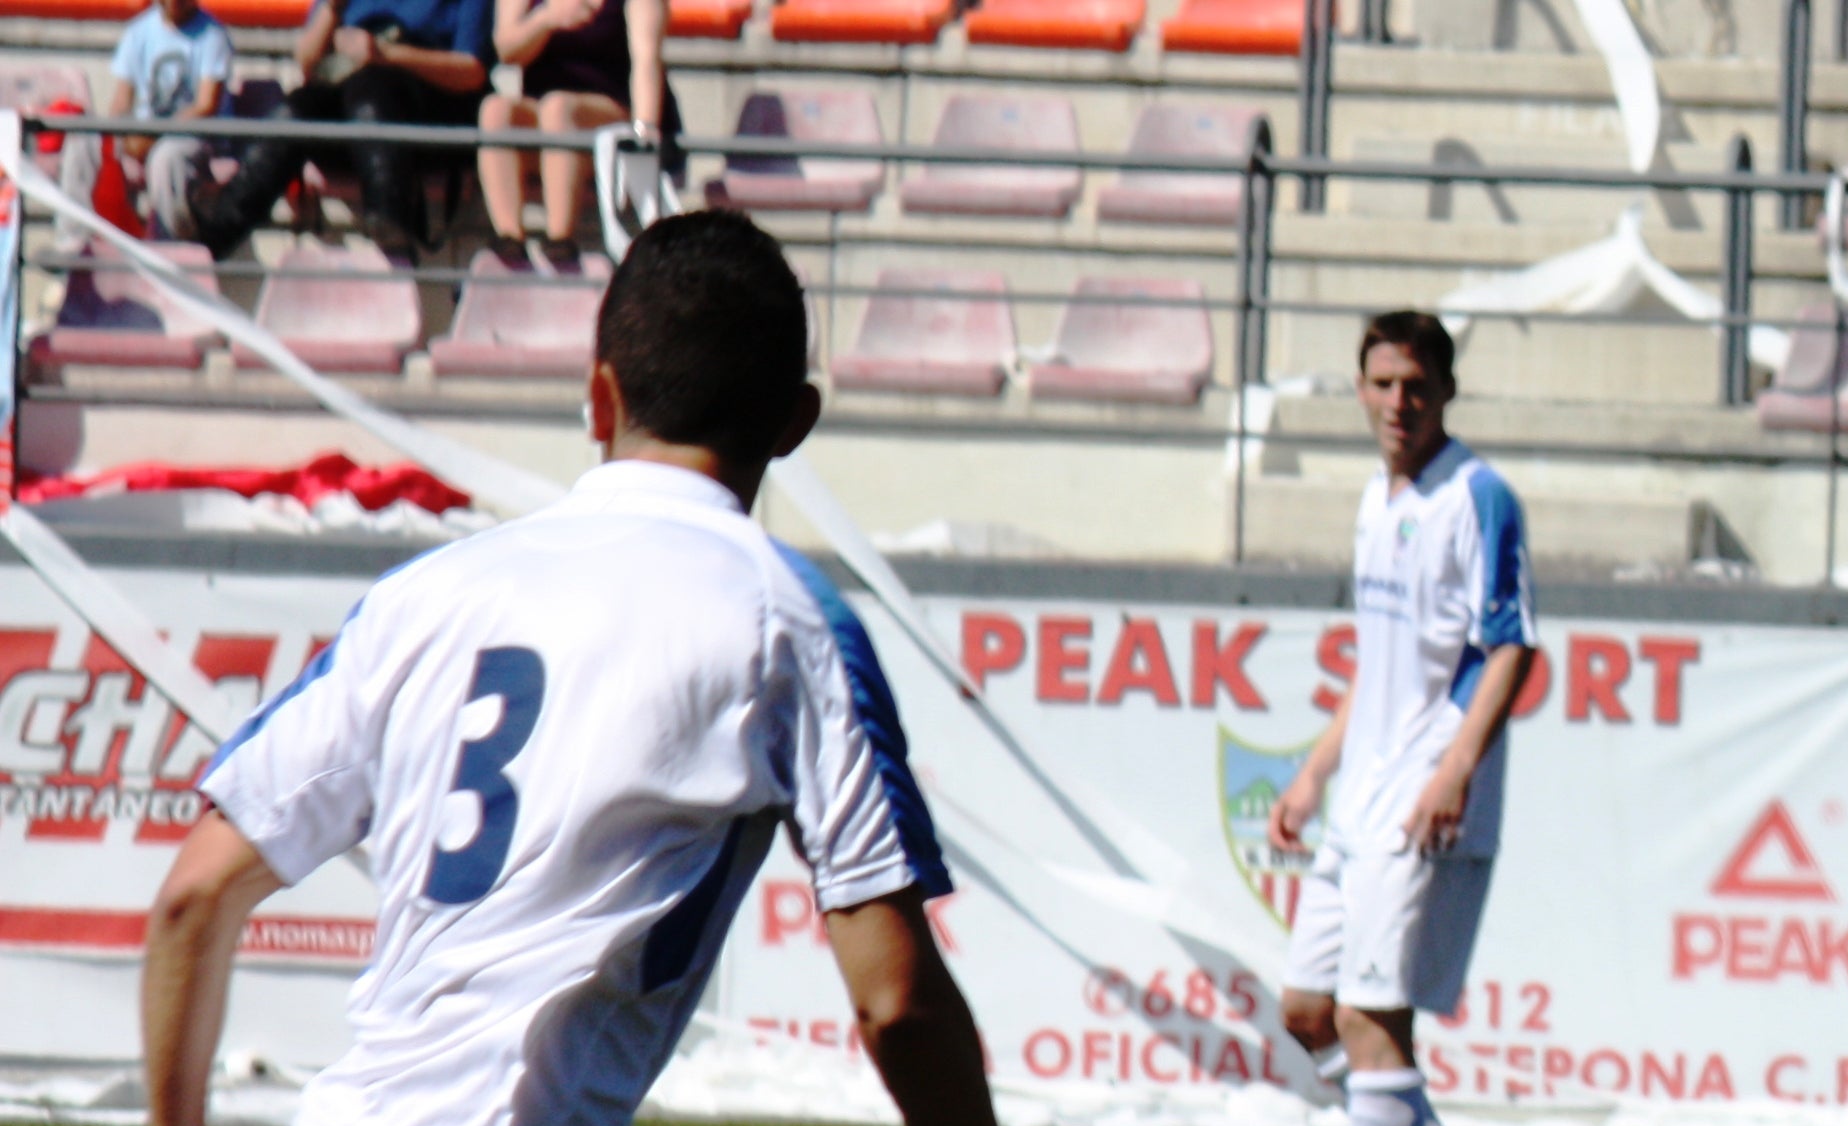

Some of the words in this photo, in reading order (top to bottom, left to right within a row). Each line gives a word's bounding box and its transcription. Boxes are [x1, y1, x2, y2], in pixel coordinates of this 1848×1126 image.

[960, 610, 1270, 712] PEAK
[422, 645, 546, 905] 3
[1141, 968, 1259, 1021] 685
[1022, 1028, 1289, 1086] OFICIAL
[1413, 1042, 1735, 1101] STEPONA
